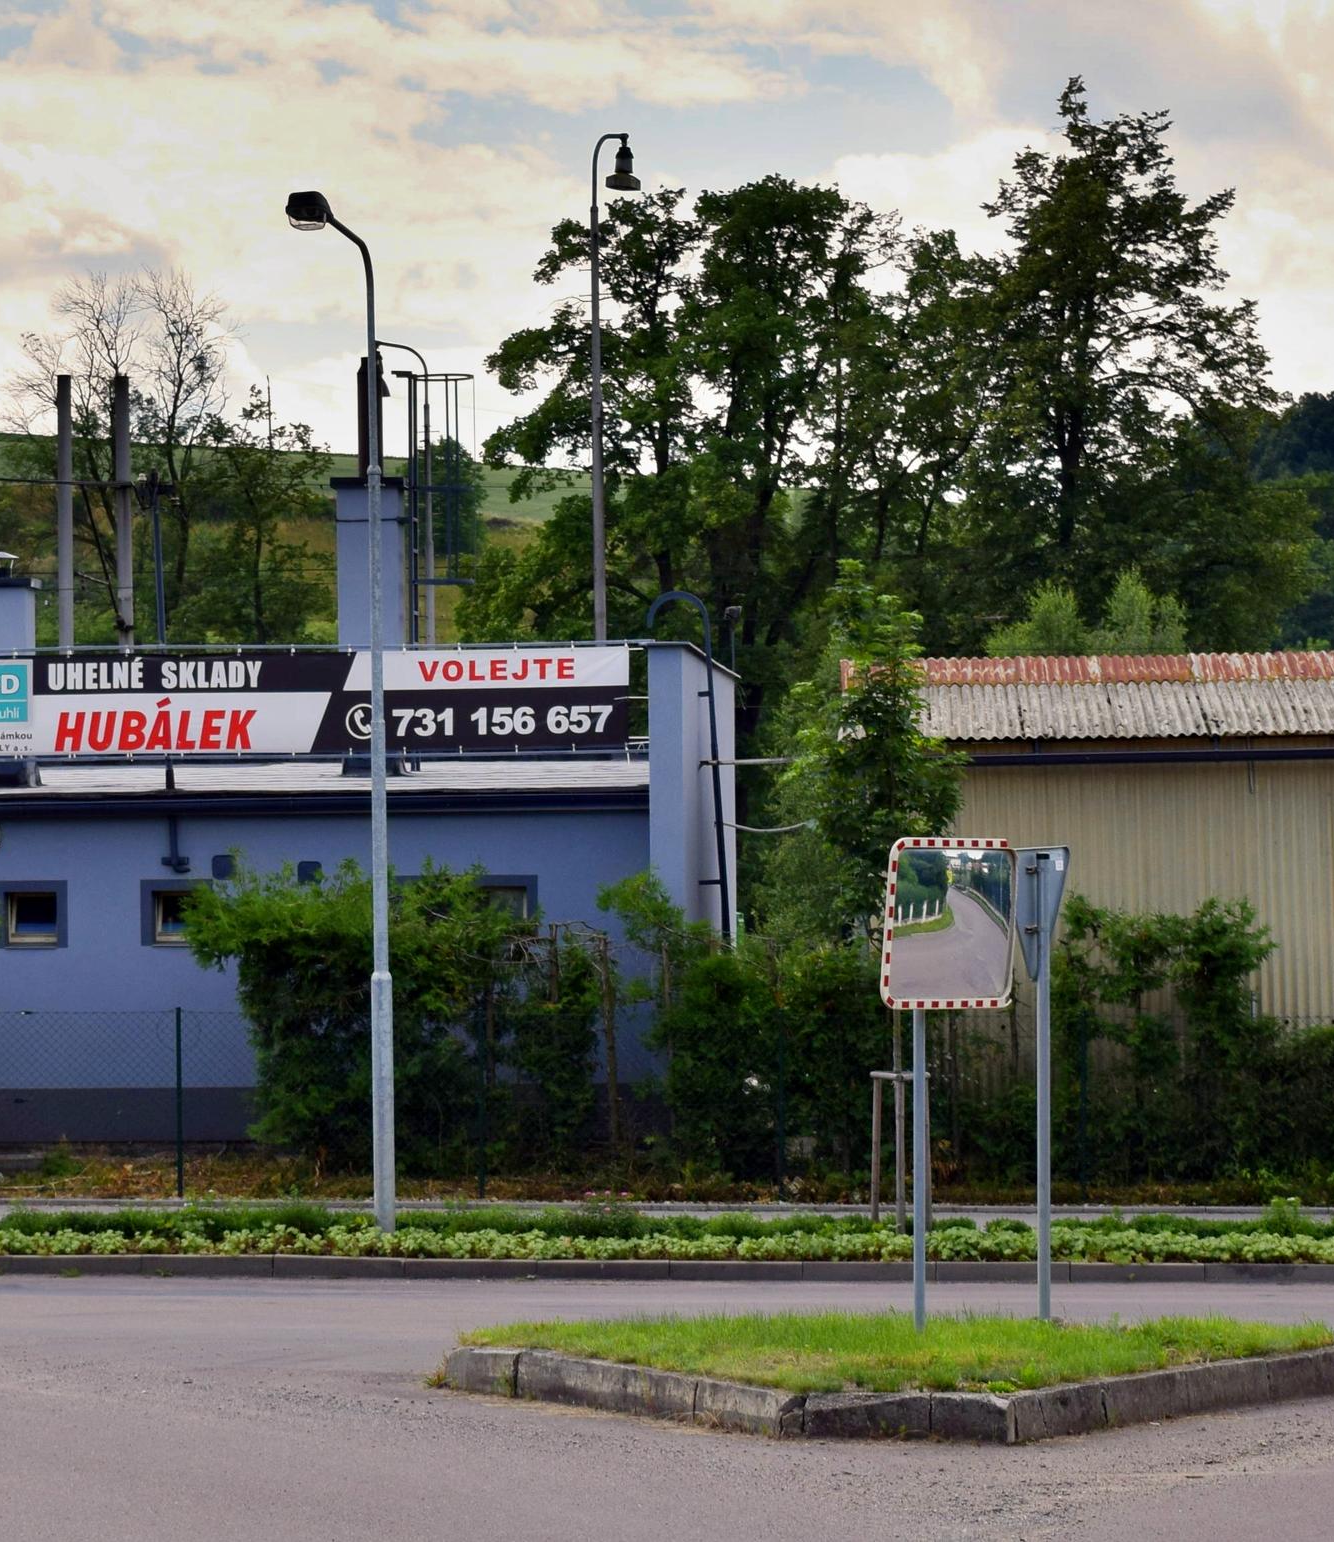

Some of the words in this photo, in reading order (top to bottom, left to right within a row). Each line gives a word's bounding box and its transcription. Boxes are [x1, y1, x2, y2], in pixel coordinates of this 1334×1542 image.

[48, 656, 144, 690] UHELNÉ
[161, 660, 263, 689] SKLADY
[418, 658, 575, 682] VOLEJTE
[54, 697, 257, 752] HUBÁLEK
[392, 708, 454, 737] 731
[470, 706, 536, 735] 156
[546, 704, 613, 734] 657
